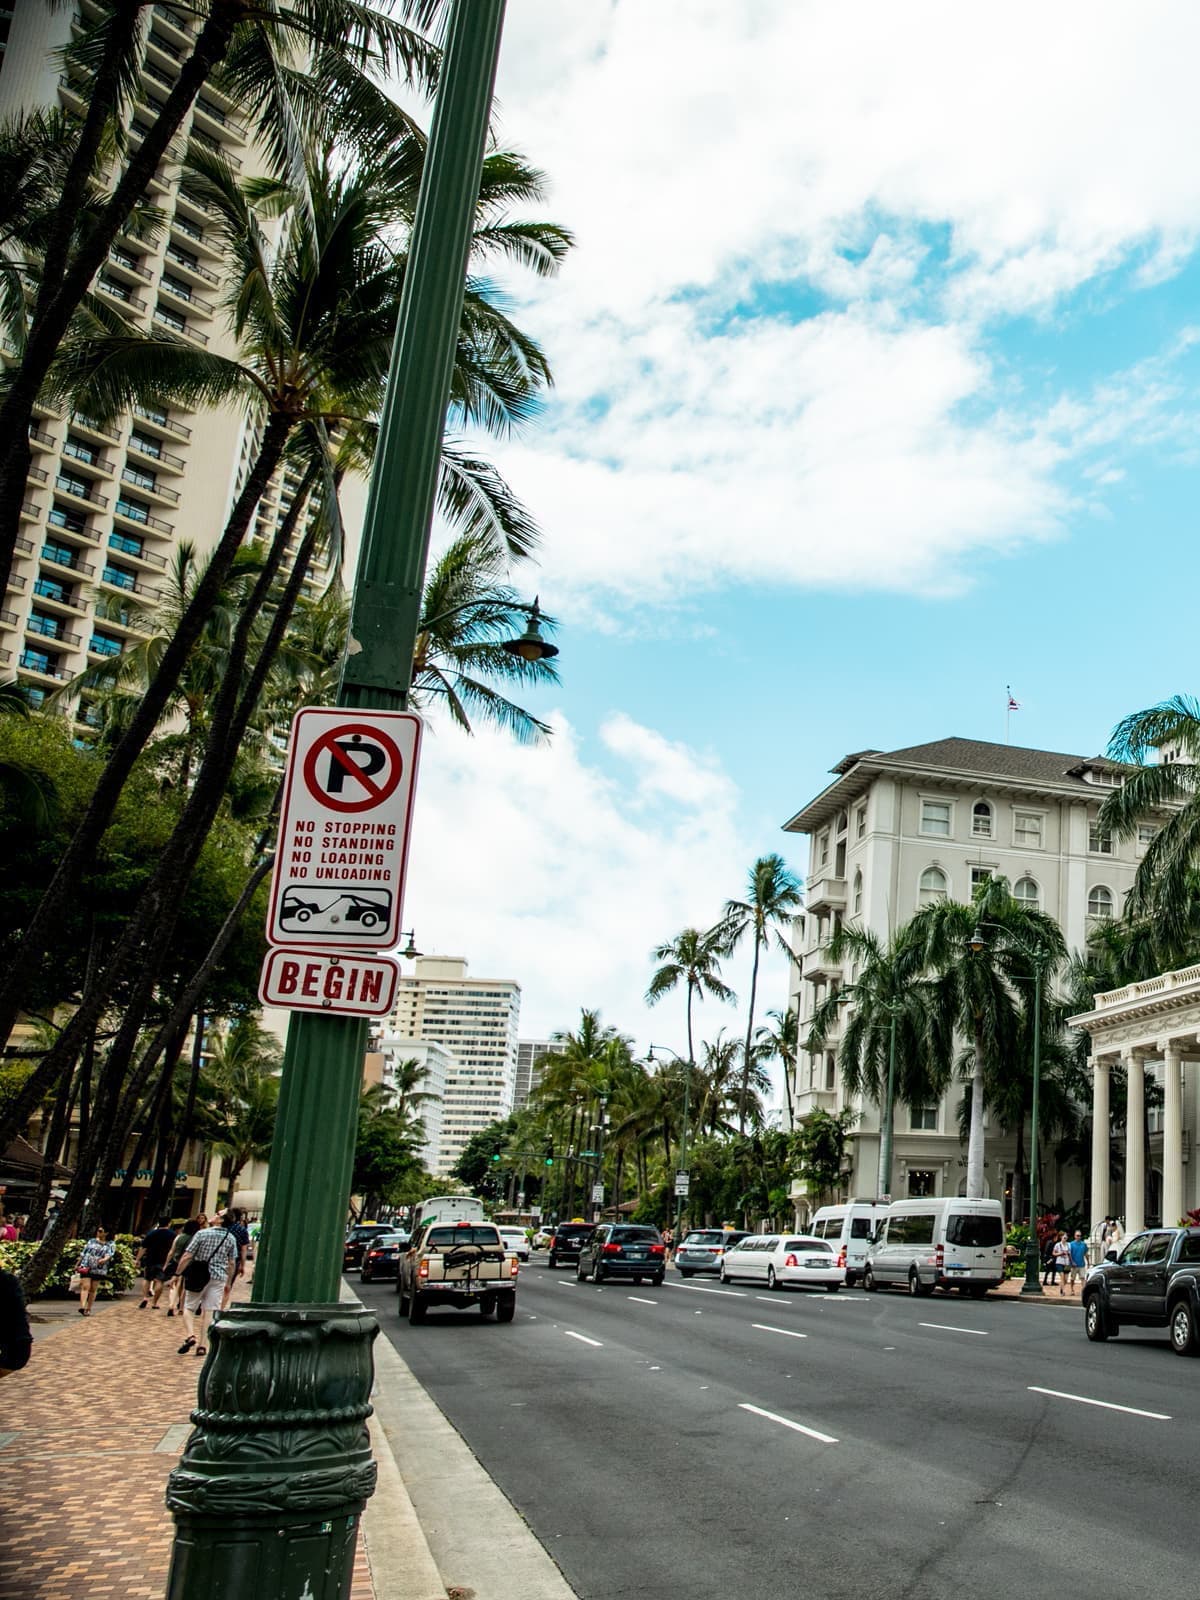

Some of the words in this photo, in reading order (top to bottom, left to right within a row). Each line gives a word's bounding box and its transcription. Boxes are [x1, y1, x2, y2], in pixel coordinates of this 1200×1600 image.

[296, 820, 316, 833] NO
[325, 822, 397, 836] STOPPING
[294, 836, 314, 848] NO
[322, 837, 395, 851] STANDING
[291, 851, 312, 863] NO
[321, 852, 385, 866] LOADING
[289, 866, 308, 879] NO
[316, 867, 392, 881] UNLOADING
[278, 961, 384, 1003] BEGIN
